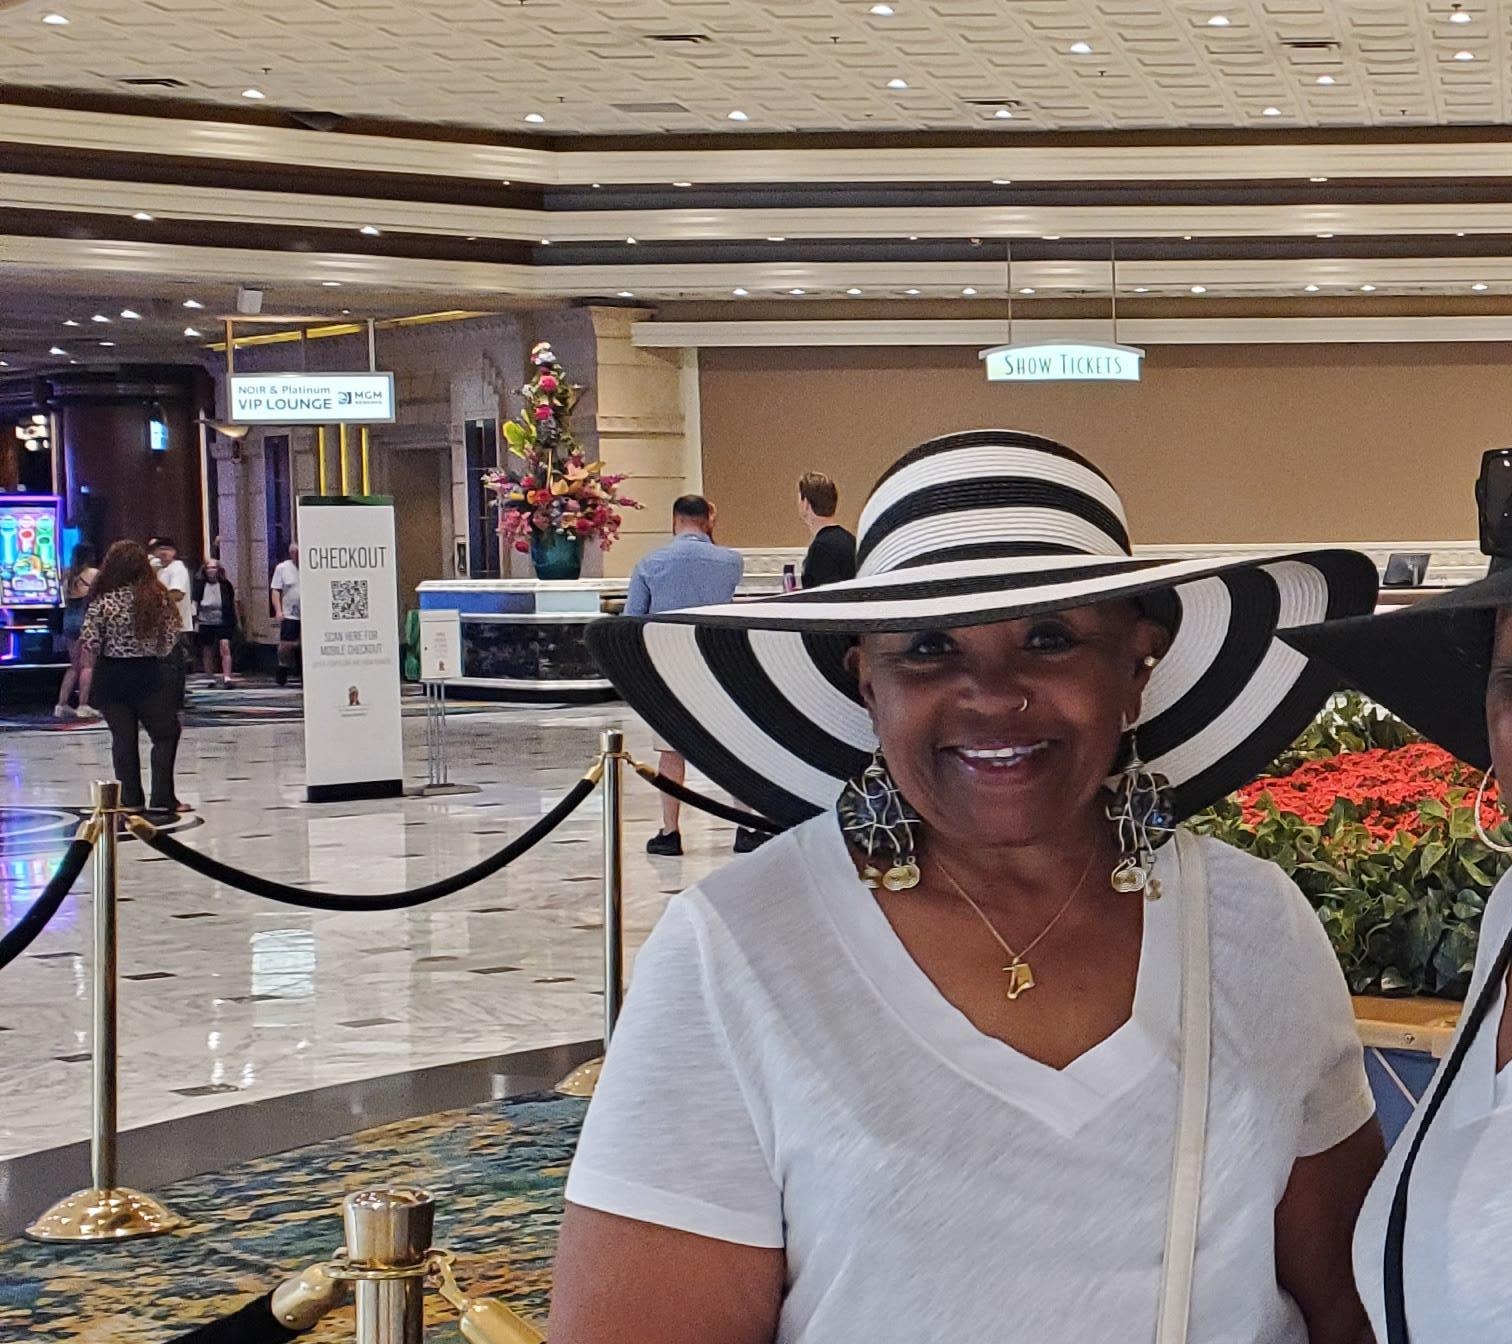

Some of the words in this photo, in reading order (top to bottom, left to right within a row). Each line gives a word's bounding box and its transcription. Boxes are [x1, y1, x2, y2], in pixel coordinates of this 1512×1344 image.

[238, 385, 266, 394] NOIR
[270, 385, 279, 394] &
[282, 384, 331, 395] Platinum
[354, 391, 383, 399] MGM
[238, 398, 263, 410] VIP
[266, 398, 333, 410] LOUNGE
[308, 546, 388, 570] CHECKOUT
[324, 631, 343, 642] SCAN
[320, 644, 345, 656] MOBILE
[347, 642, 382, 655] CHECKOUT
